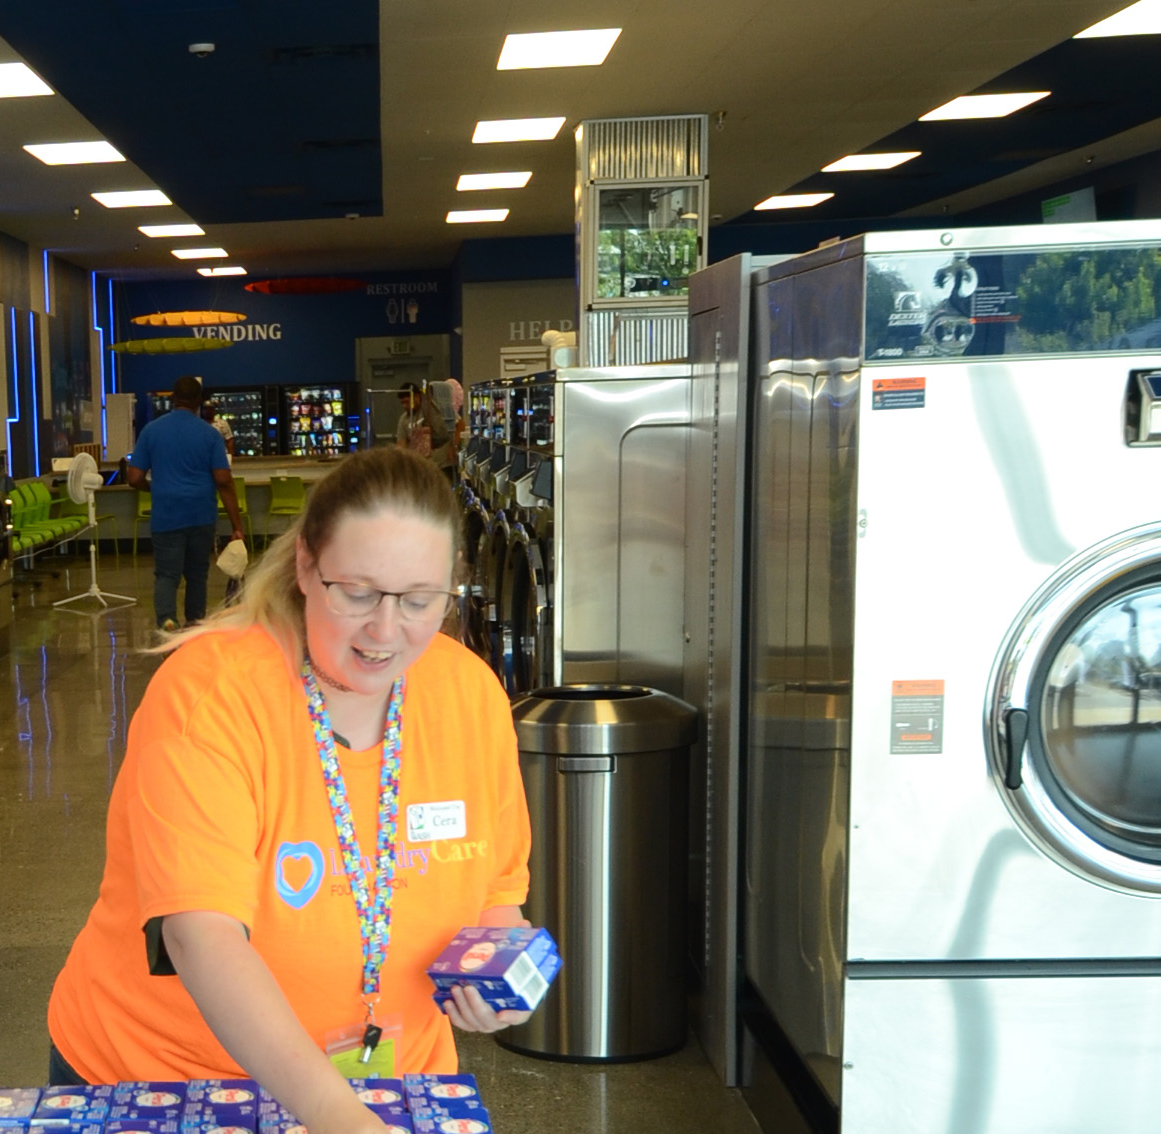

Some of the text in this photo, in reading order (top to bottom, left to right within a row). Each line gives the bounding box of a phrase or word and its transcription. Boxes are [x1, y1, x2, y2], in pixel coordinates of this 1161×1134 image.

[366, 280, 438, 296] RESTROOM
[192, 323, 282, 341] VENDING
[433, 816, 458, 827] Cera
